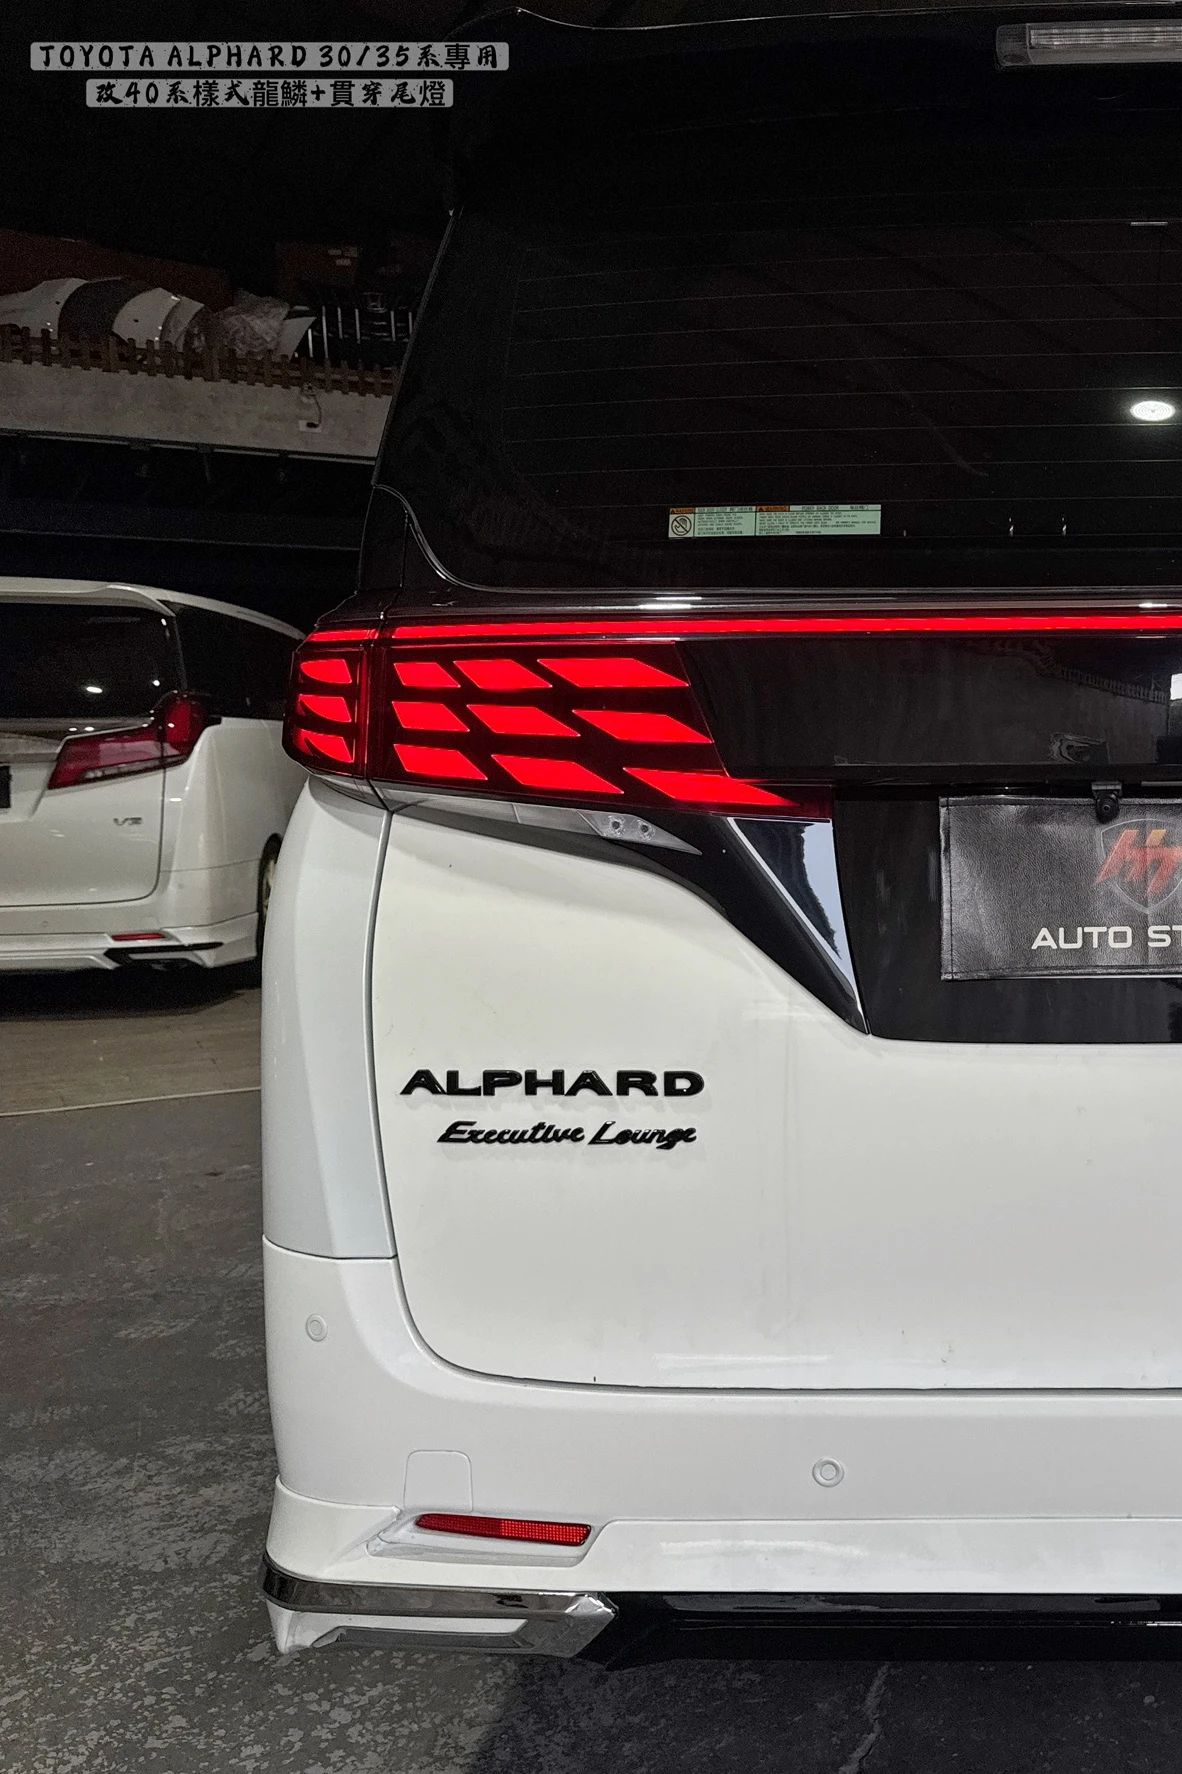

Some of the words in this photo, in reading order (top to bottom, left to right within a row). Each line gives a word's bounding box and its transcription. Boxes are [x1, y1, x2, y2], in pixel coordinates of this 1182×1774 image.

[1030, 925, 1133, 950] AUTO
[399, 1068, 705, 1097] ALPHARD
[436, 1120, 585, 1143] Executive
[587, 1120, 697, 1150] Lounge
